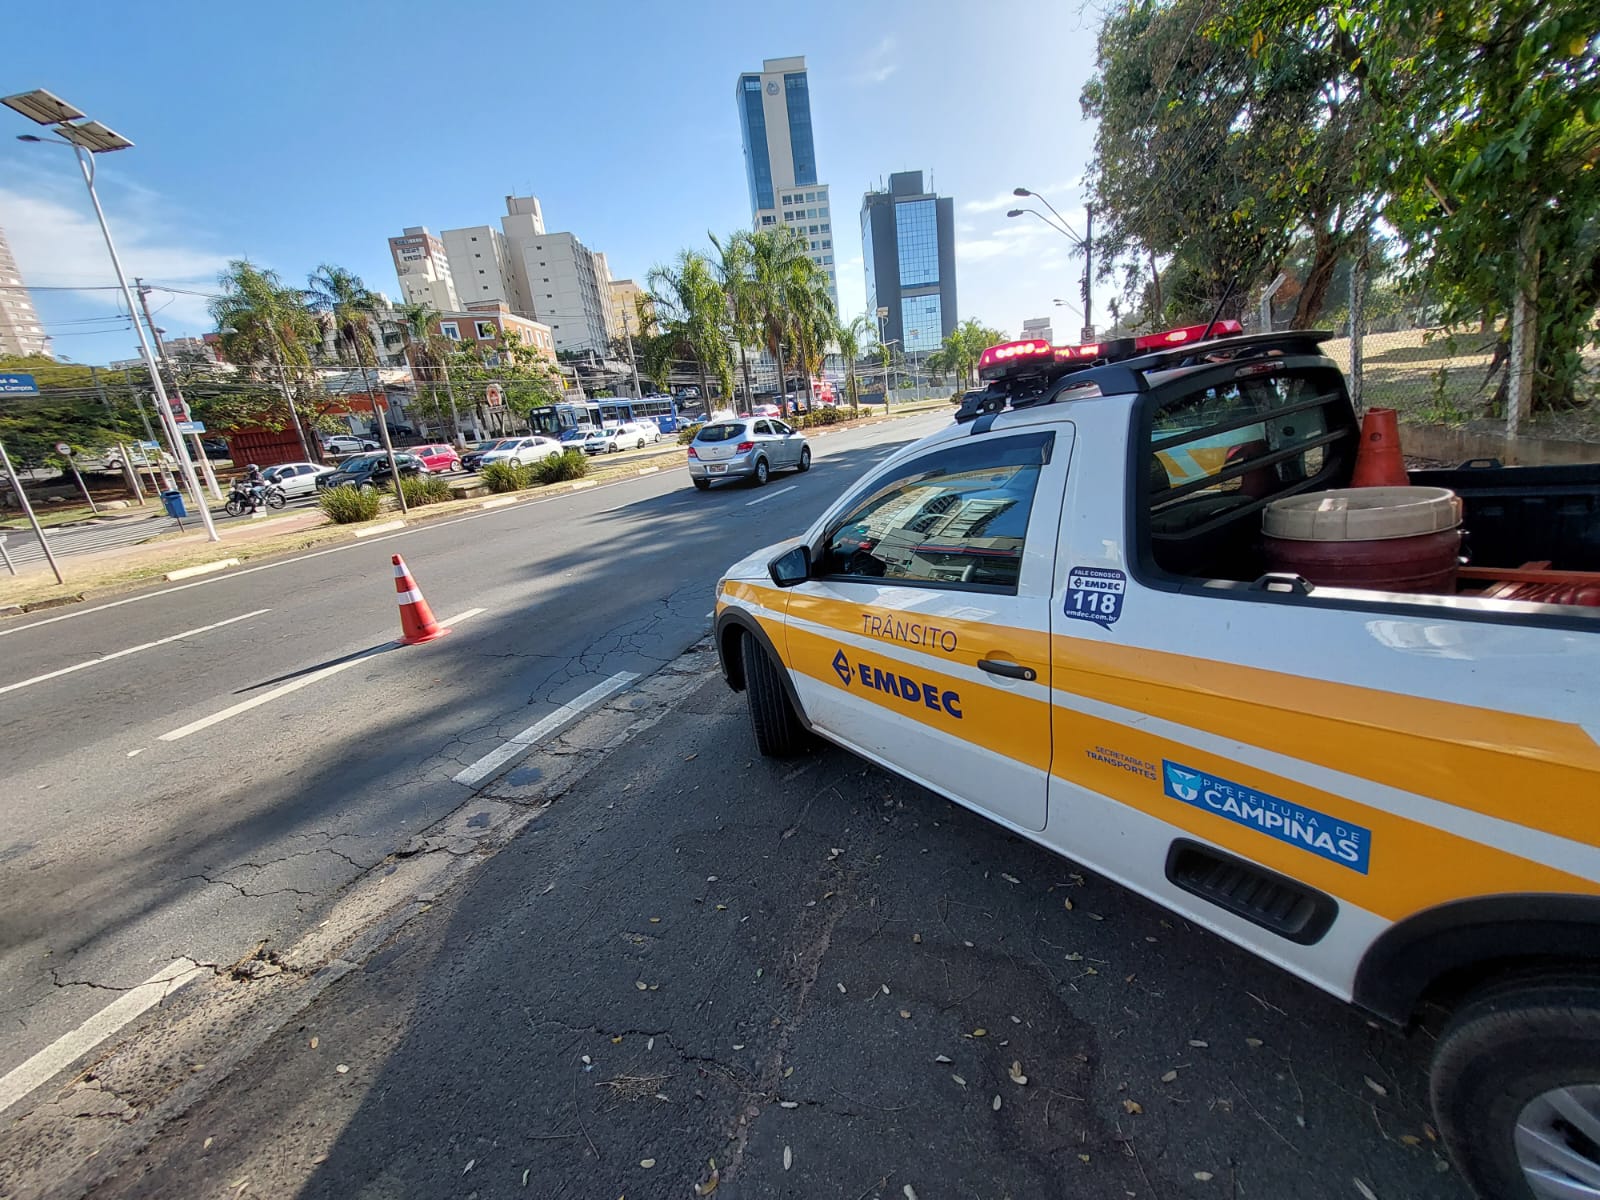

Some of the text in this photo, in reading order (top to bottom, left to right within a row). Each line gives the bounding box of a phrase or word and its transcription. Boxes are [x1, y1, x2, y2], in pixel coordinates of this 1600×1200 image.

[1085, 580, 1121, 591] EMDEC
[1090, 571, 1121, 579] CONOSCO
[1066, 610, 1117, 622] emdec.com.br
[1073, 591, 1116, 614] 118
[862, 614, 957, 652] TRÂNSITO
[858, 663, 963, 719] EMDEC
[1085, 750, 1157, 780] TRANSPORTES
[1095, 746, 1156, 771] SECRETARIA DE
[1203, 778, 1360, 843] PREFEITURA DE
[1204, 789, 1360, 863] CAMPINAS
